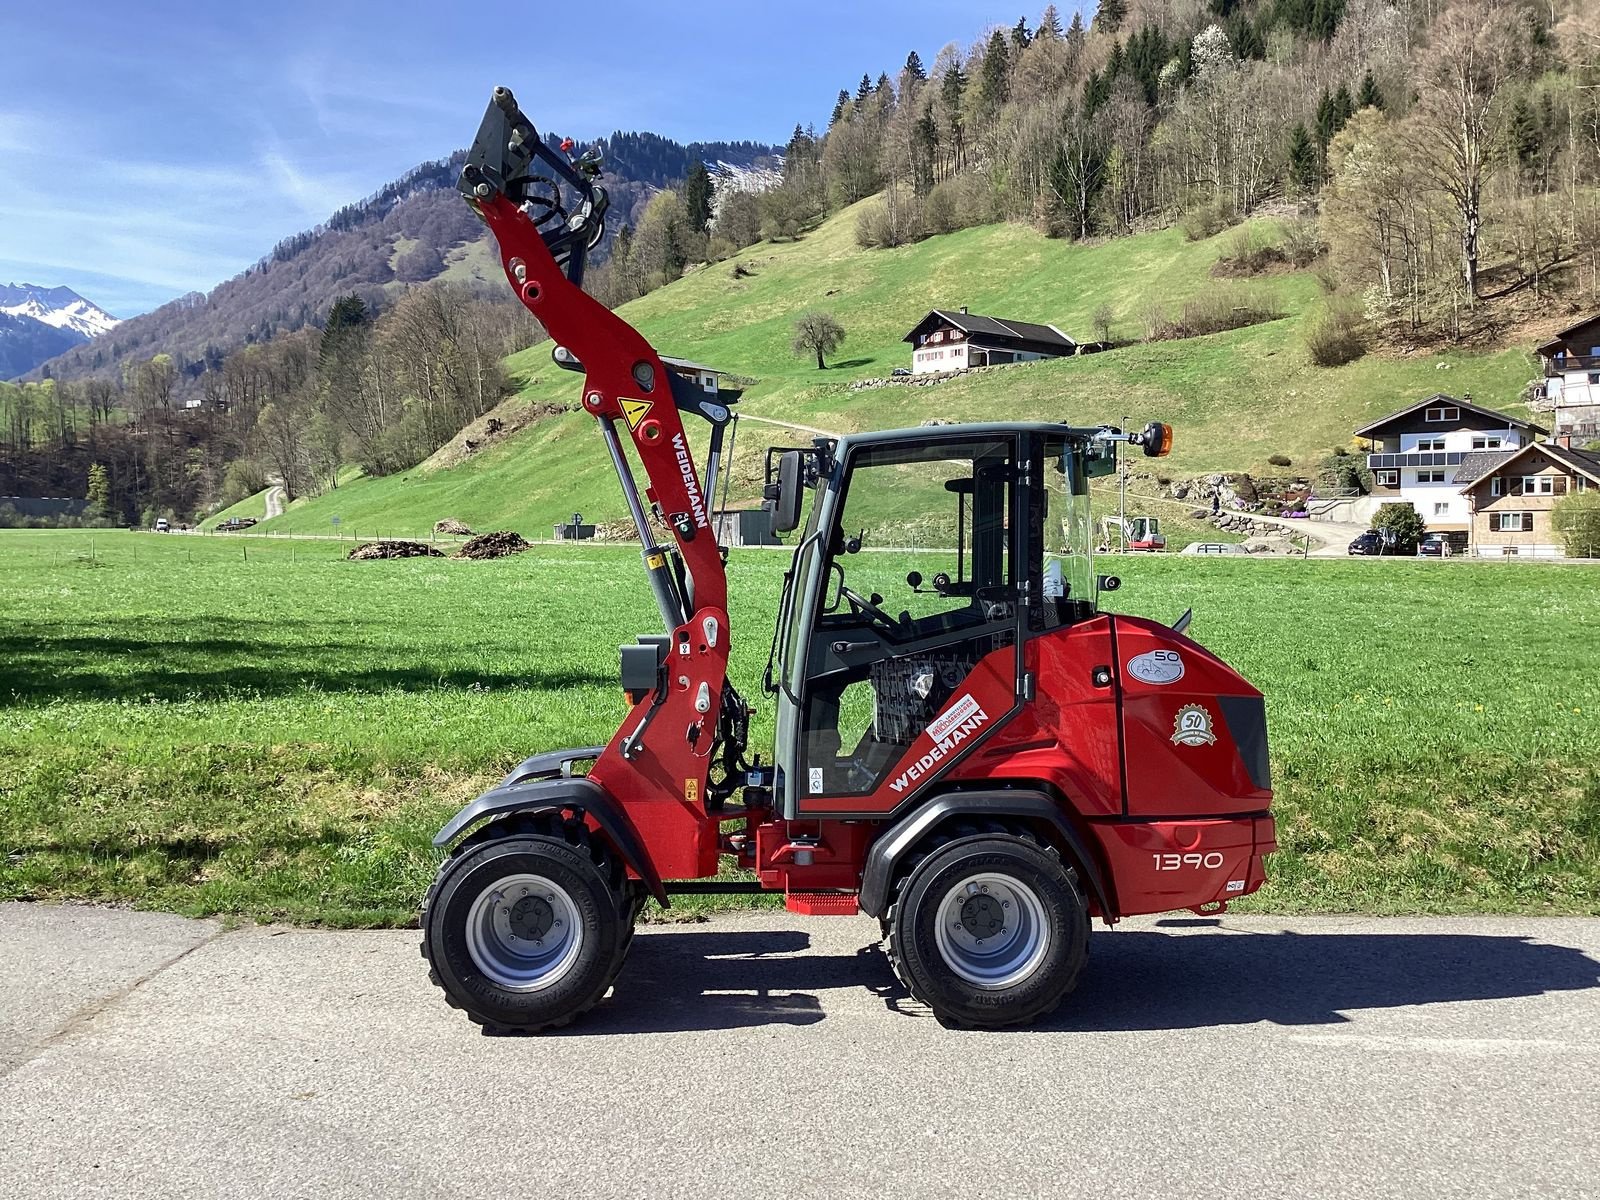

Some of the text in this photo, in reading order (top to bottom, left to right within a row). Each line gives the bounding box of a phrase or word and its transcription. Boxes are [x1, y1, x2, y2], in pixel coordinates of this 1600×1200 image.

[672, 432, 708, 529] WEIDEMANN
[1155, 652, 1180, 662] 50
[1185, 714, 1202, 729] 50
[889, 709, 989, 792] WEIDEMANN
[1153, 852, 1224, 871] 1390
